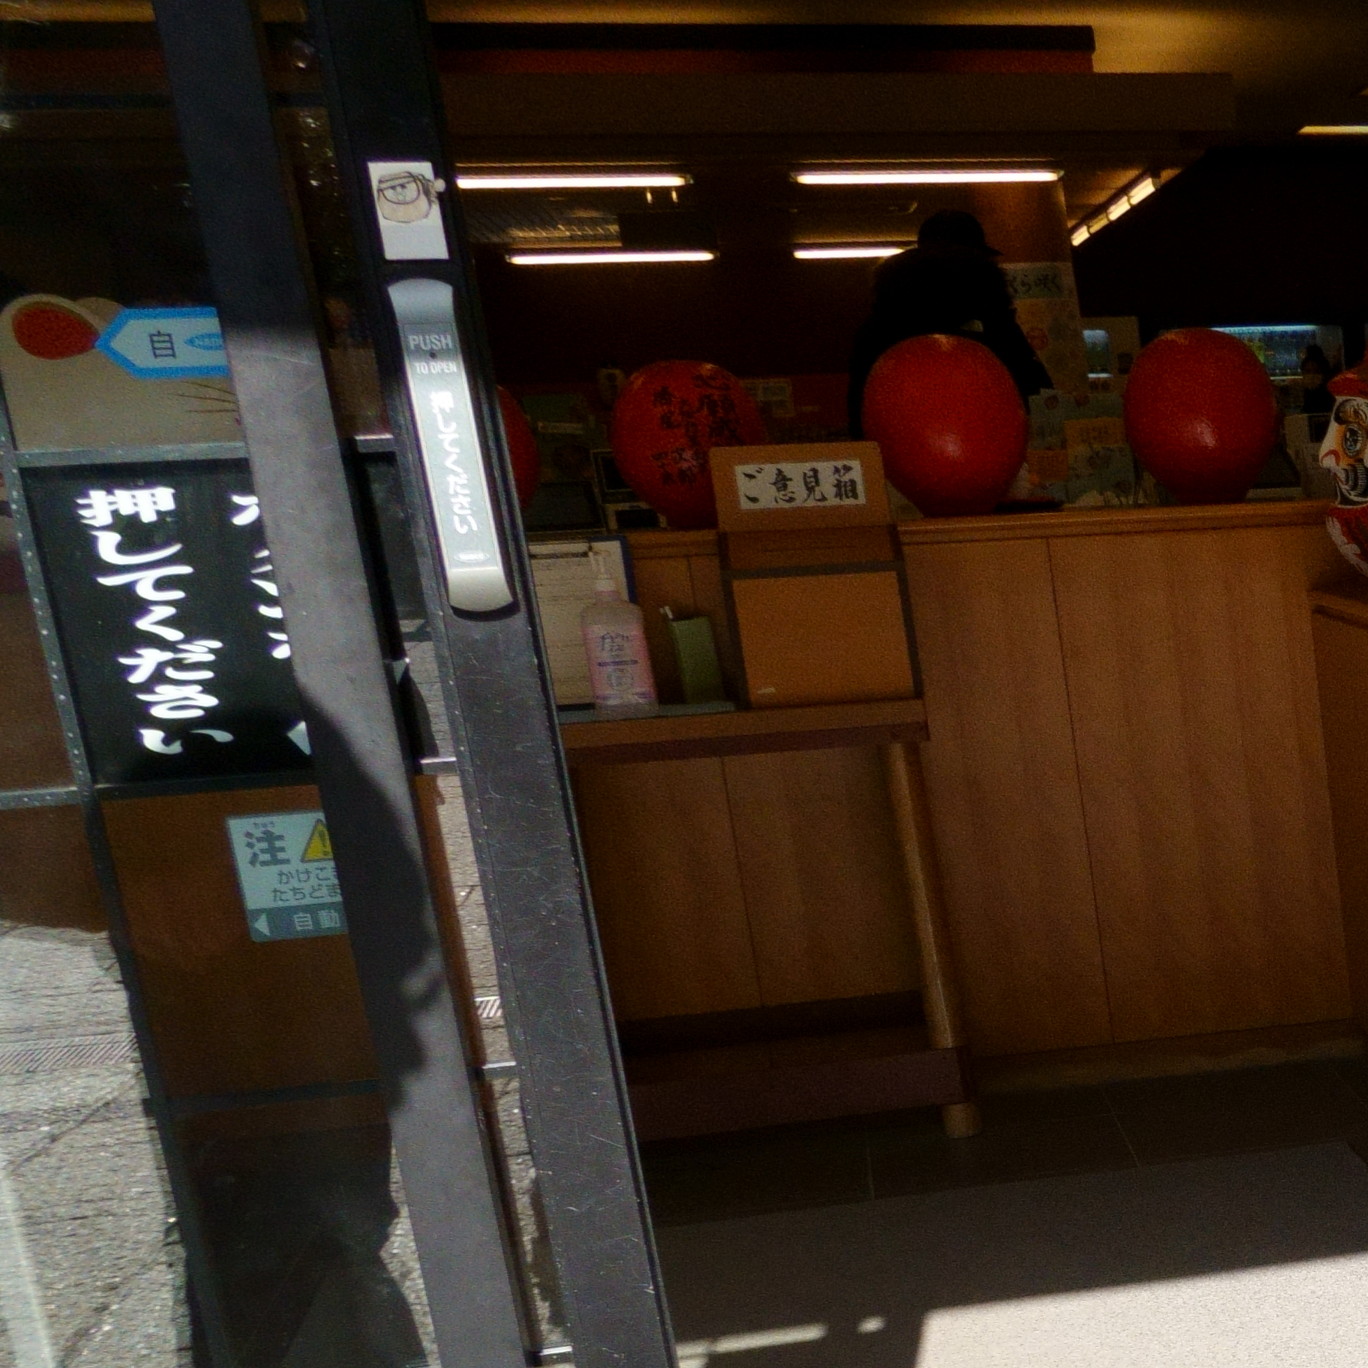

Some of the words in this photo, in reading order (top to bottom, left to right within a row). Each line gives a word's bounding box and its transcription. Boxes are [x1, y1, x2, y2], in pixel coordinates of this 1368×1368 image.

[149, 330, 176, 359] 自
[407, 334, 453, 350] PUSH
[415, 361, 429, 374] TO
[430, 360, 458, 374] OPEN
[428, 390, 479, 535] 押してください
[741, 463, 860, 504] ご意見箱
[75, 486, 235, 756] 押してください
[244, 828, 291, 868] 注
